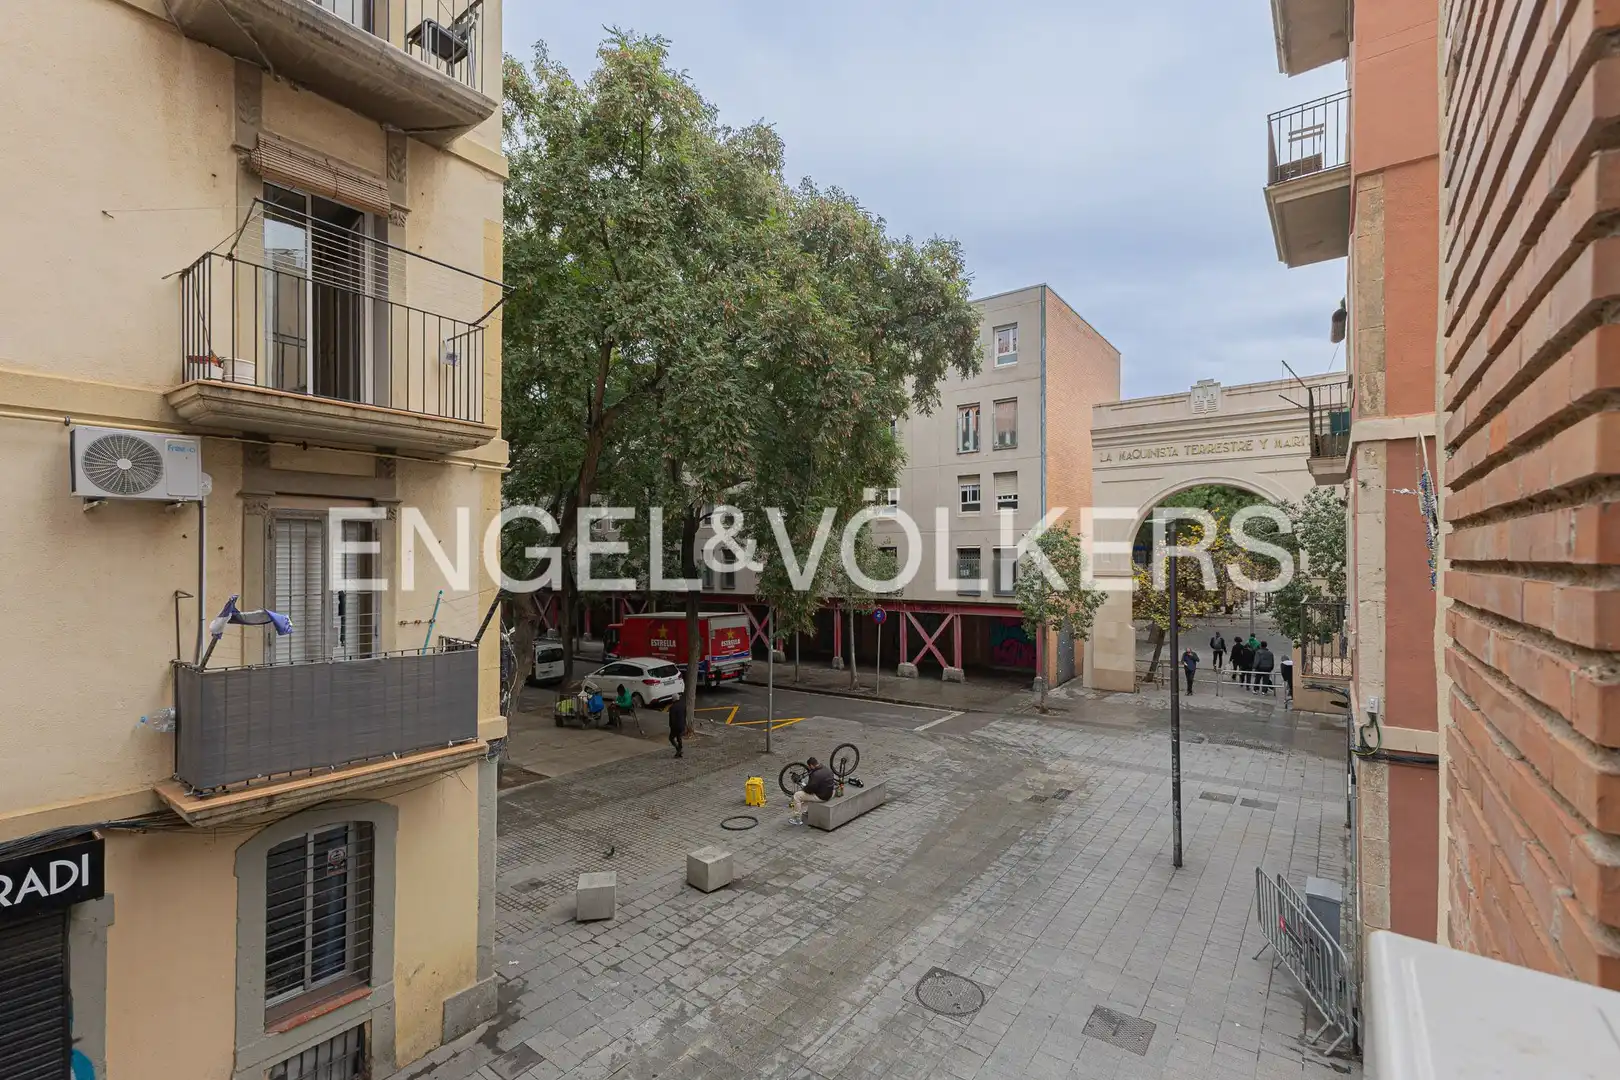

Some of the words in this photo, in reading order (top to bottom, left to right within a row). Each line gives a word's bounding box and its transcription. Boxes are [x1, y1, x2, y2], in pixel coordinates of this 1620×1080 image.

[1100, 451, 1113, 463] LA
[1118, 446, 1179, 461] MAQUINISTA
[1184, 440, 1253, 456] TERRESTRE
[1259, 438, 1269, 450] Y
[650, 639, 677, 648] ESTRELLA
[721, 638, 741, 647] ESTRELLA
